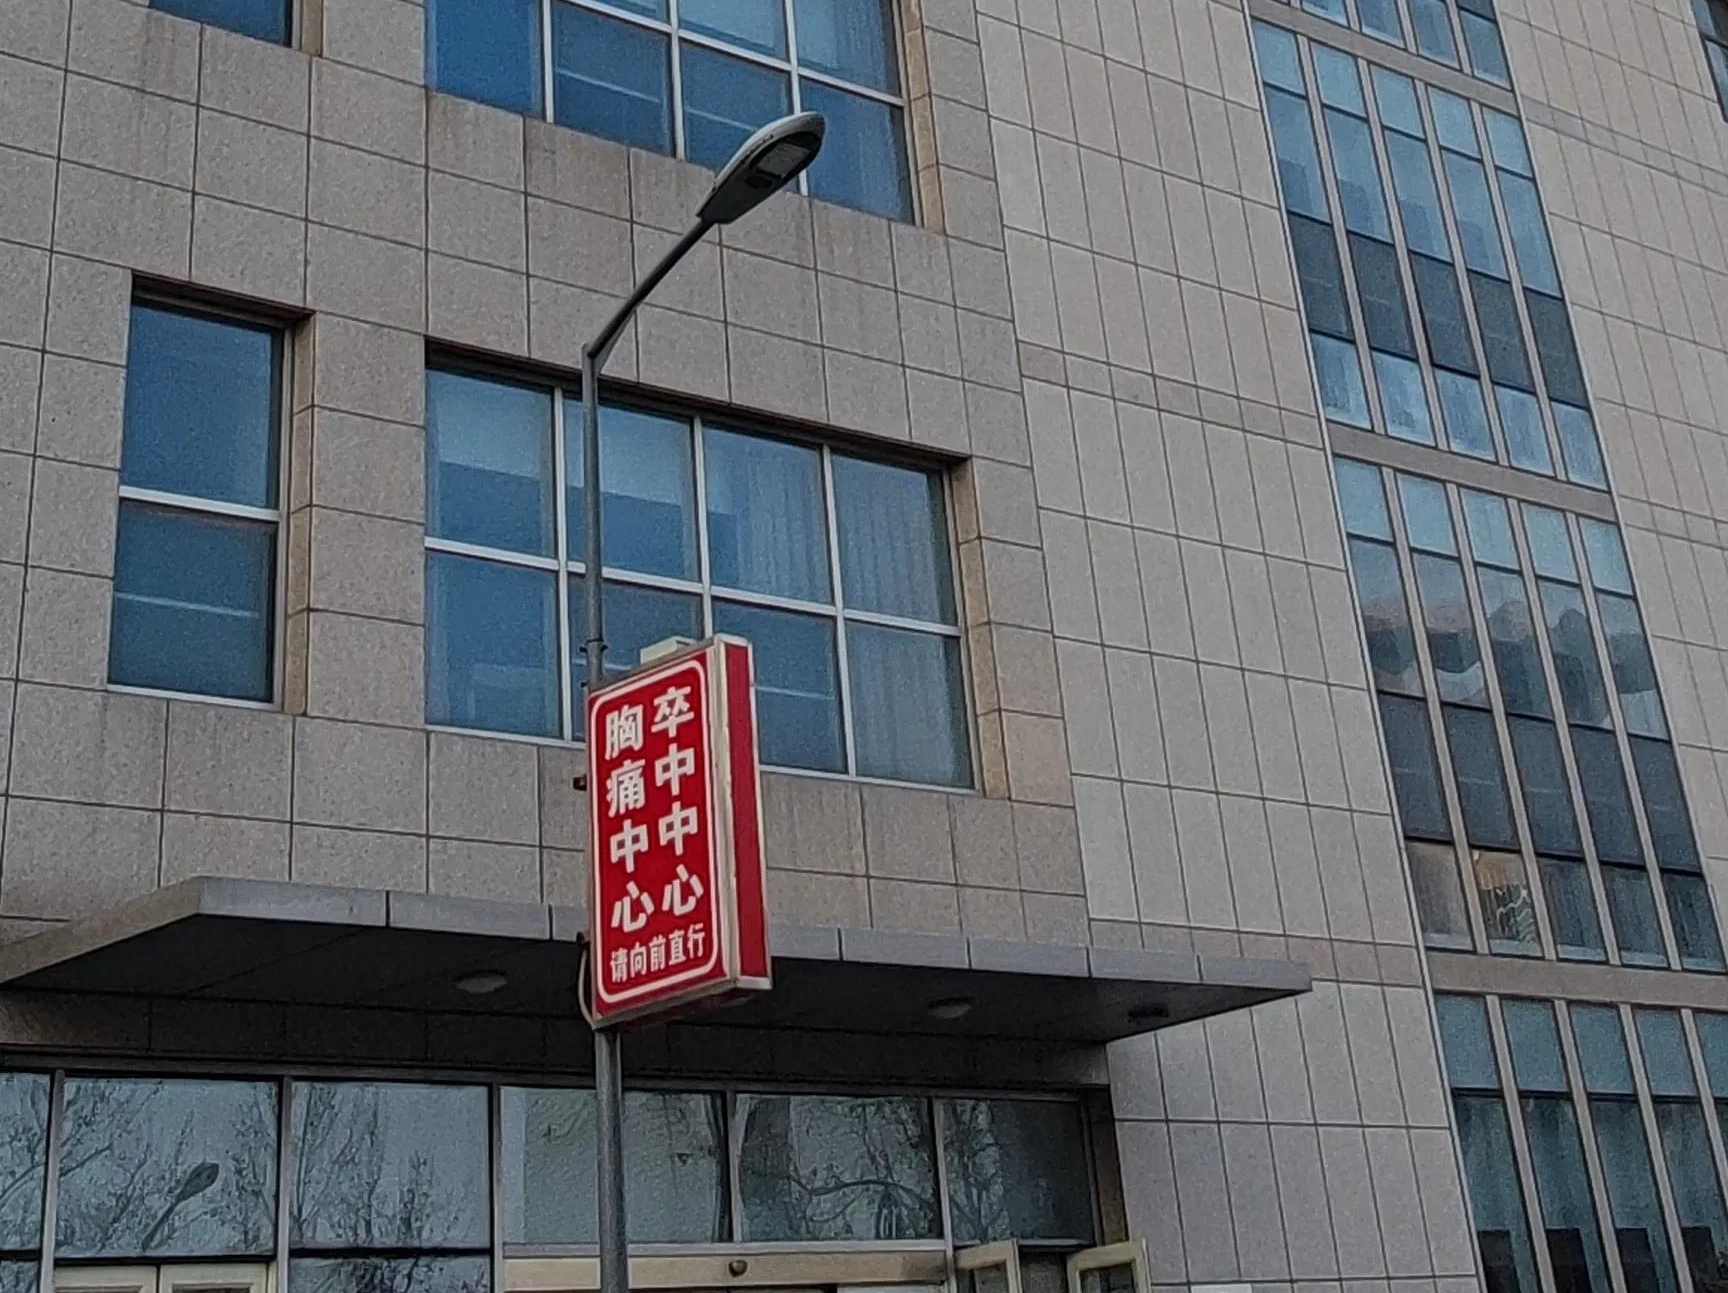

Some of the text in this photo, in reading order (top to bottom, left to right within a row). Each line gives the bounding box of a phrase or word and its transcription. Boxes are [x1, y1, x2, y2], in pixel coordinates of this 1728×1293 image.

[604, 702, 655, 933] 胸痛中心
[650, 685, 704, 918] 卒中中心
[609, 923, 706, 984] 请向前直行
